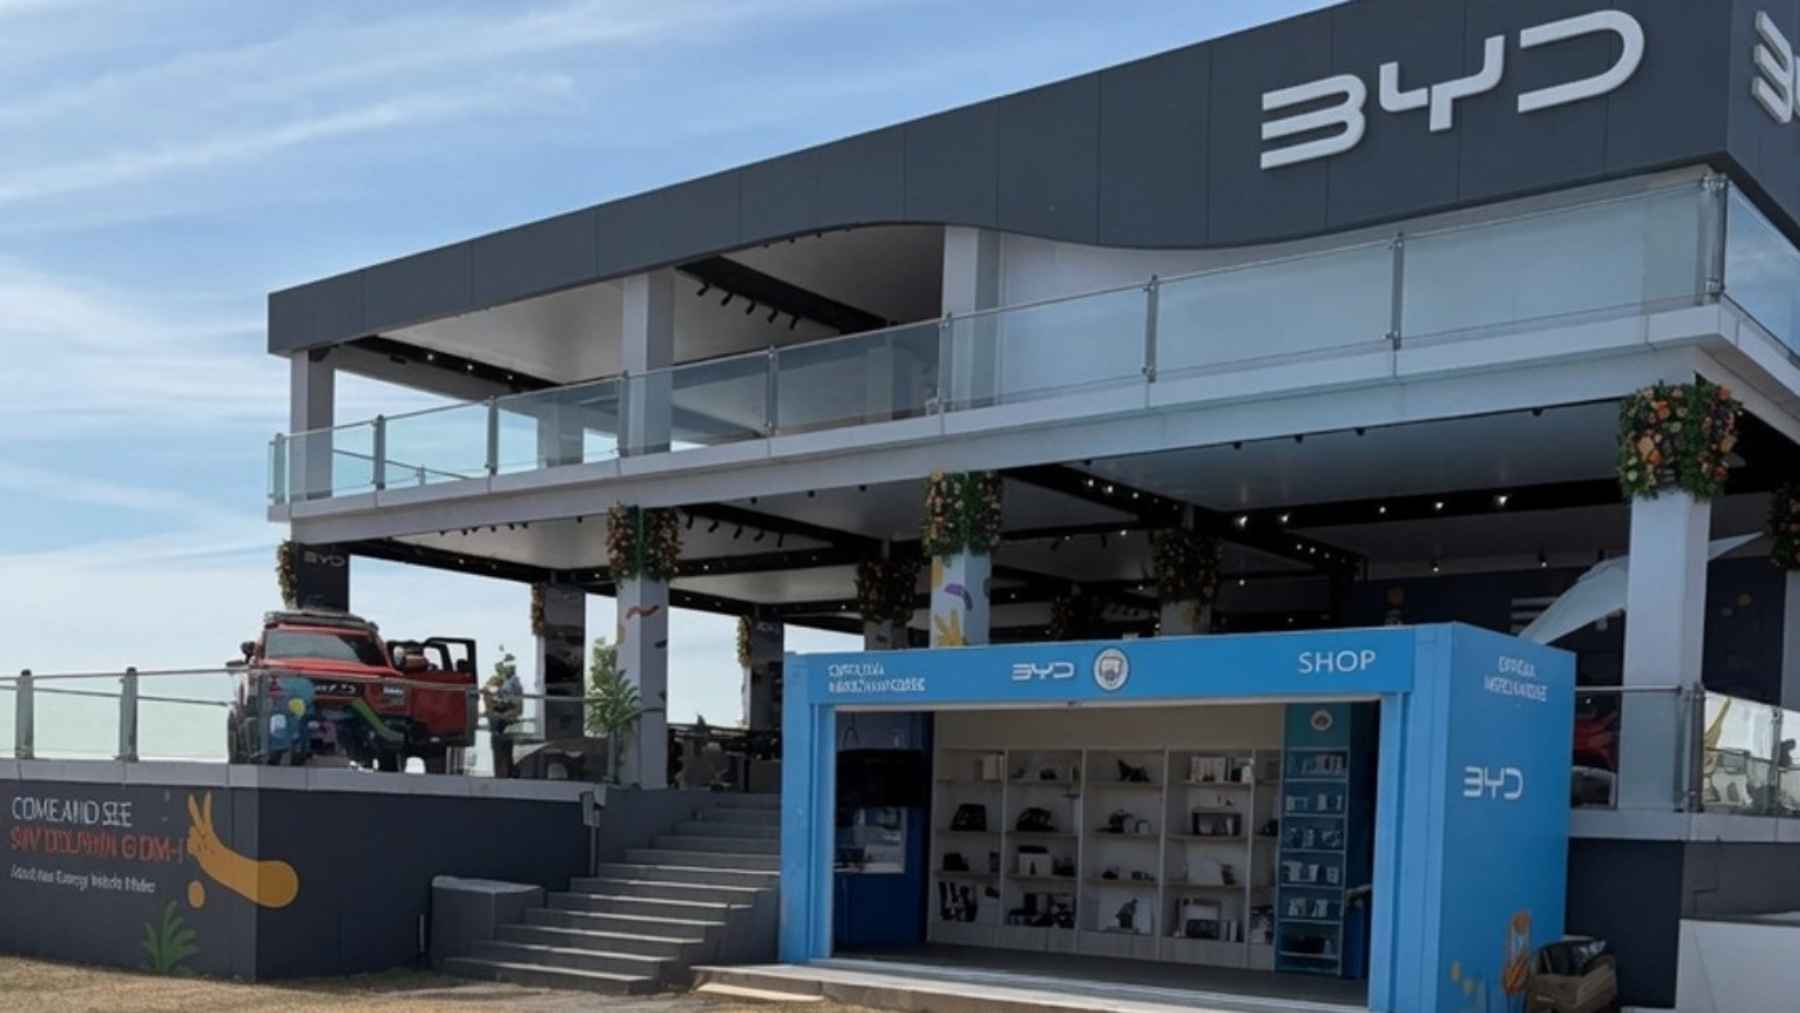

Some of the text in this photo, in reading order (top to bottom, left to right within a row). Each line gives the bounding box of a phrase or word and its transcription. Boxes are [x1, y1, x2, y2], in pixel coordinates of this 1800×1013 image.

[1261, 9, 1645, 169] BYD
[1012, 662, 1074, 680] BYD
[1298, 649, 1376, 674] SHOP
[1464, 766, 1523, 799] BYD
